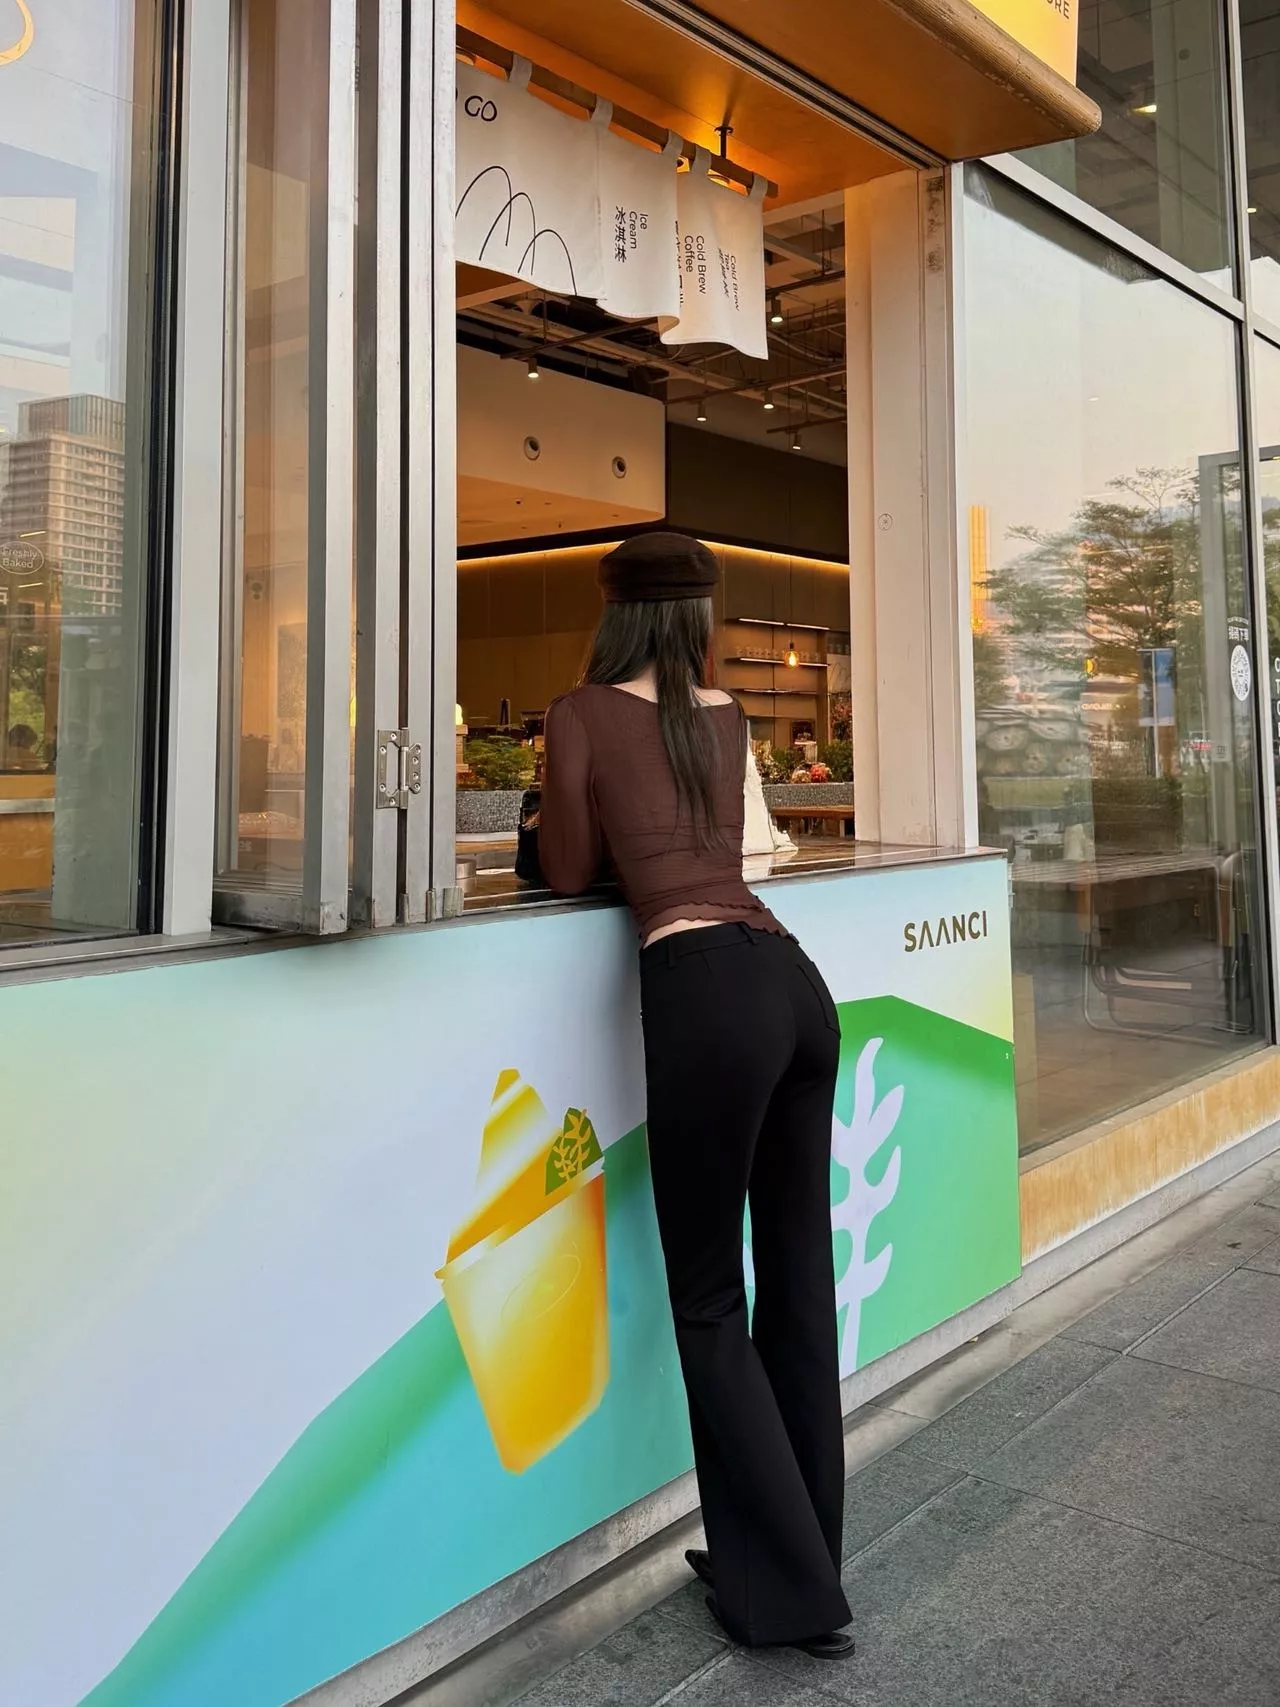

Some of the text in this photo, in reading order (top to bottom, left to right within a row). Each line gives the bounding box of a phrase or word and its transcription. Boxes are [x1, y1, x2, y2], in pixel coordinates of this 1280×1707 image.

[1046, 0, 1070, 20] RE
[464, 95, 498, 122] GO
[614, 205, 627, 263] 冰淇淋
[629, 210, 638, 249] Cream
[639, 213, 649, 230] Ice
[684, 235, 695, 273] Coffee
[696, 235, 707, 295] Cold Brew
[730, 255, 738, 281] Cold
[2, 557, 34, 568] Baked
